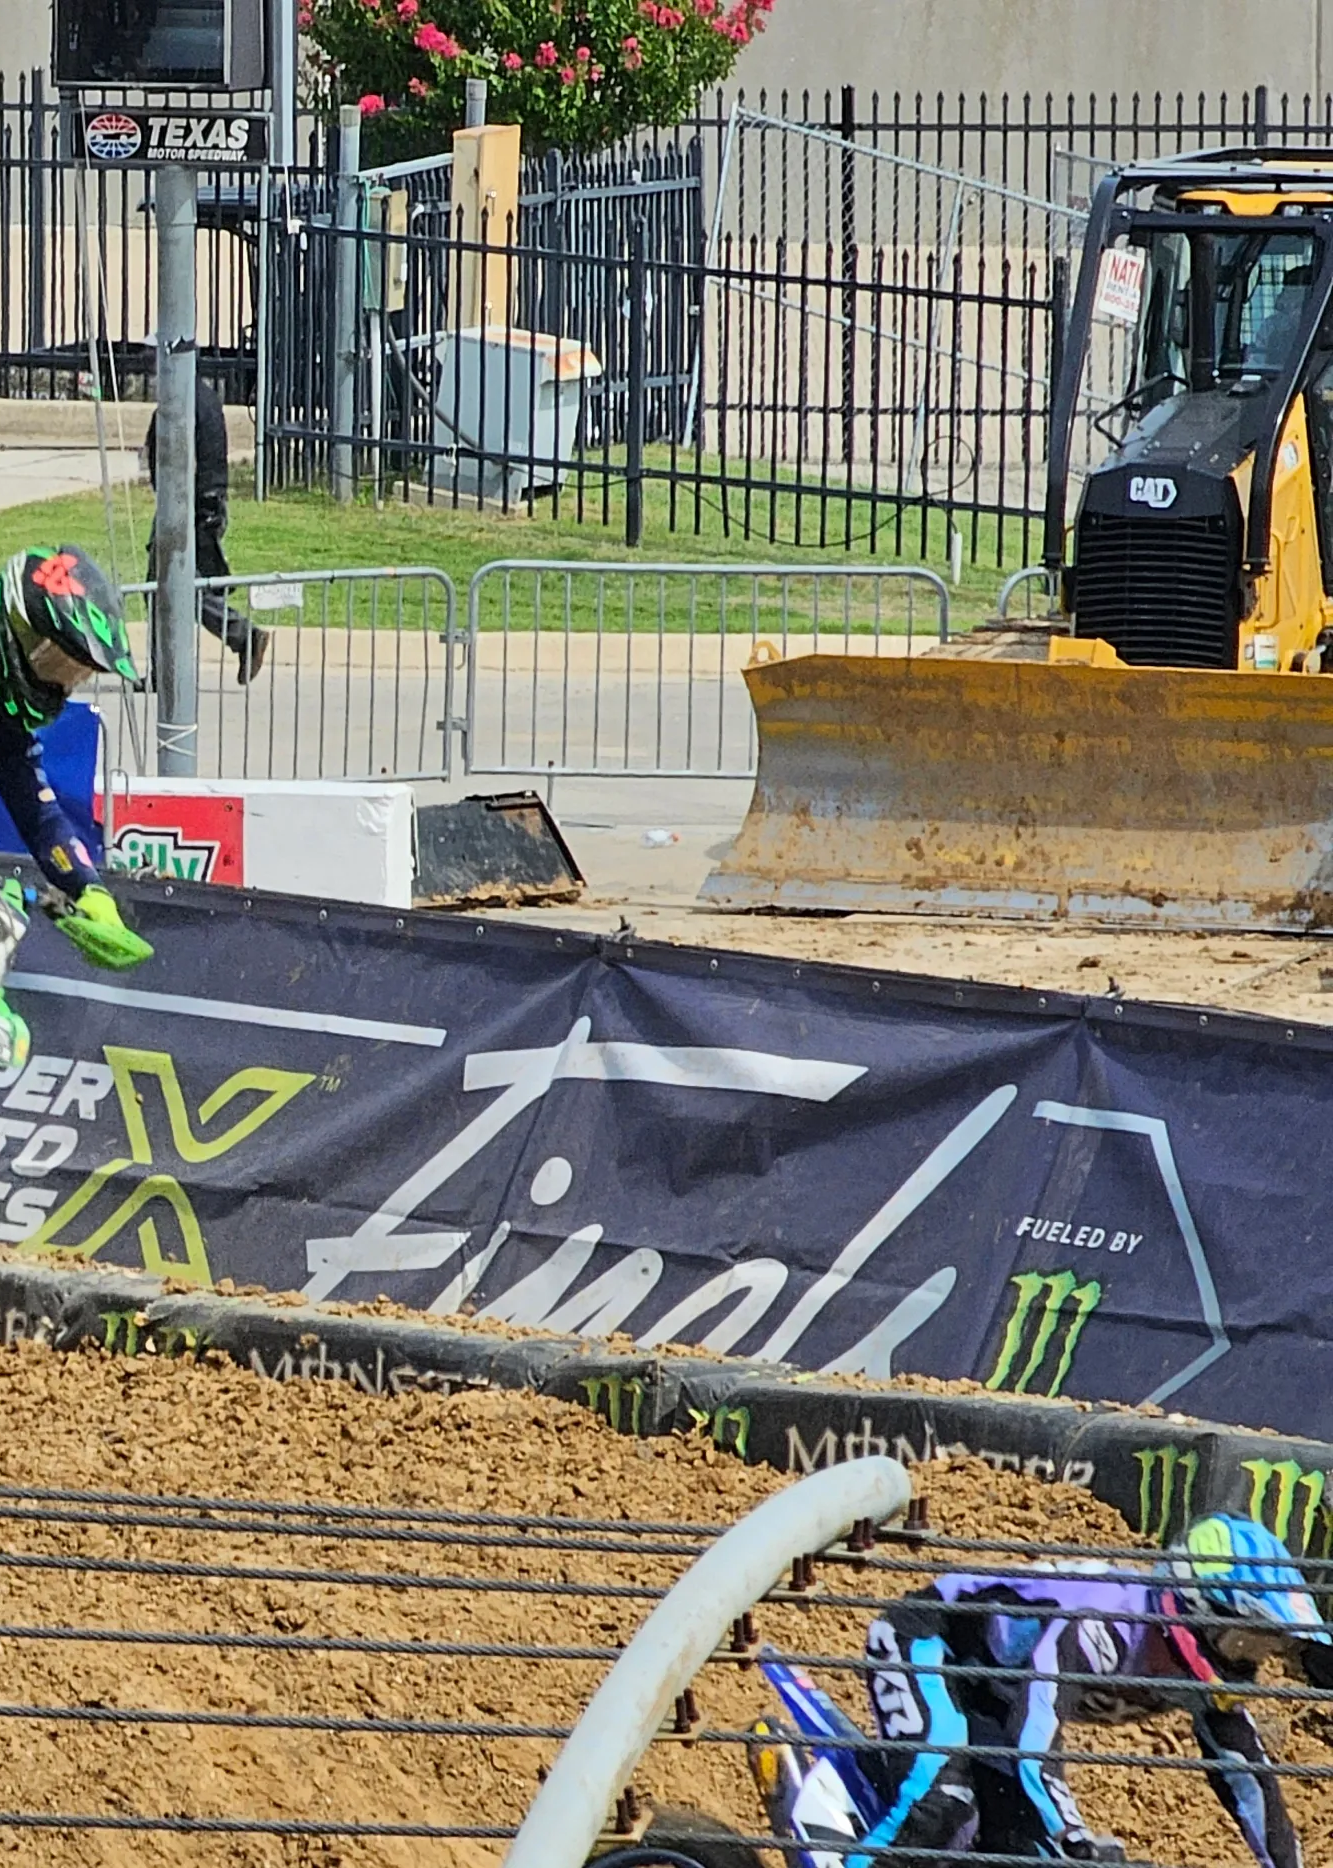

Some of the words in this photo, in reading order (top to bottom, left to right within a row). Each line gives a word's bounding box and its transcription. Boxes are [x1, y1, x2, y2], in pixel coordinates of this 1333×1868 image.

[147, 117, 250, 150] TEXAS
[147, 147, 185, 159] MOTOR
[1130, 477, 1177, 507] CAT
[303, 1014, 1019, 1382] Finals
[1015, 1215, 1107, 1249] FUELED
[1109, 1230, 1143, 1256] BY
